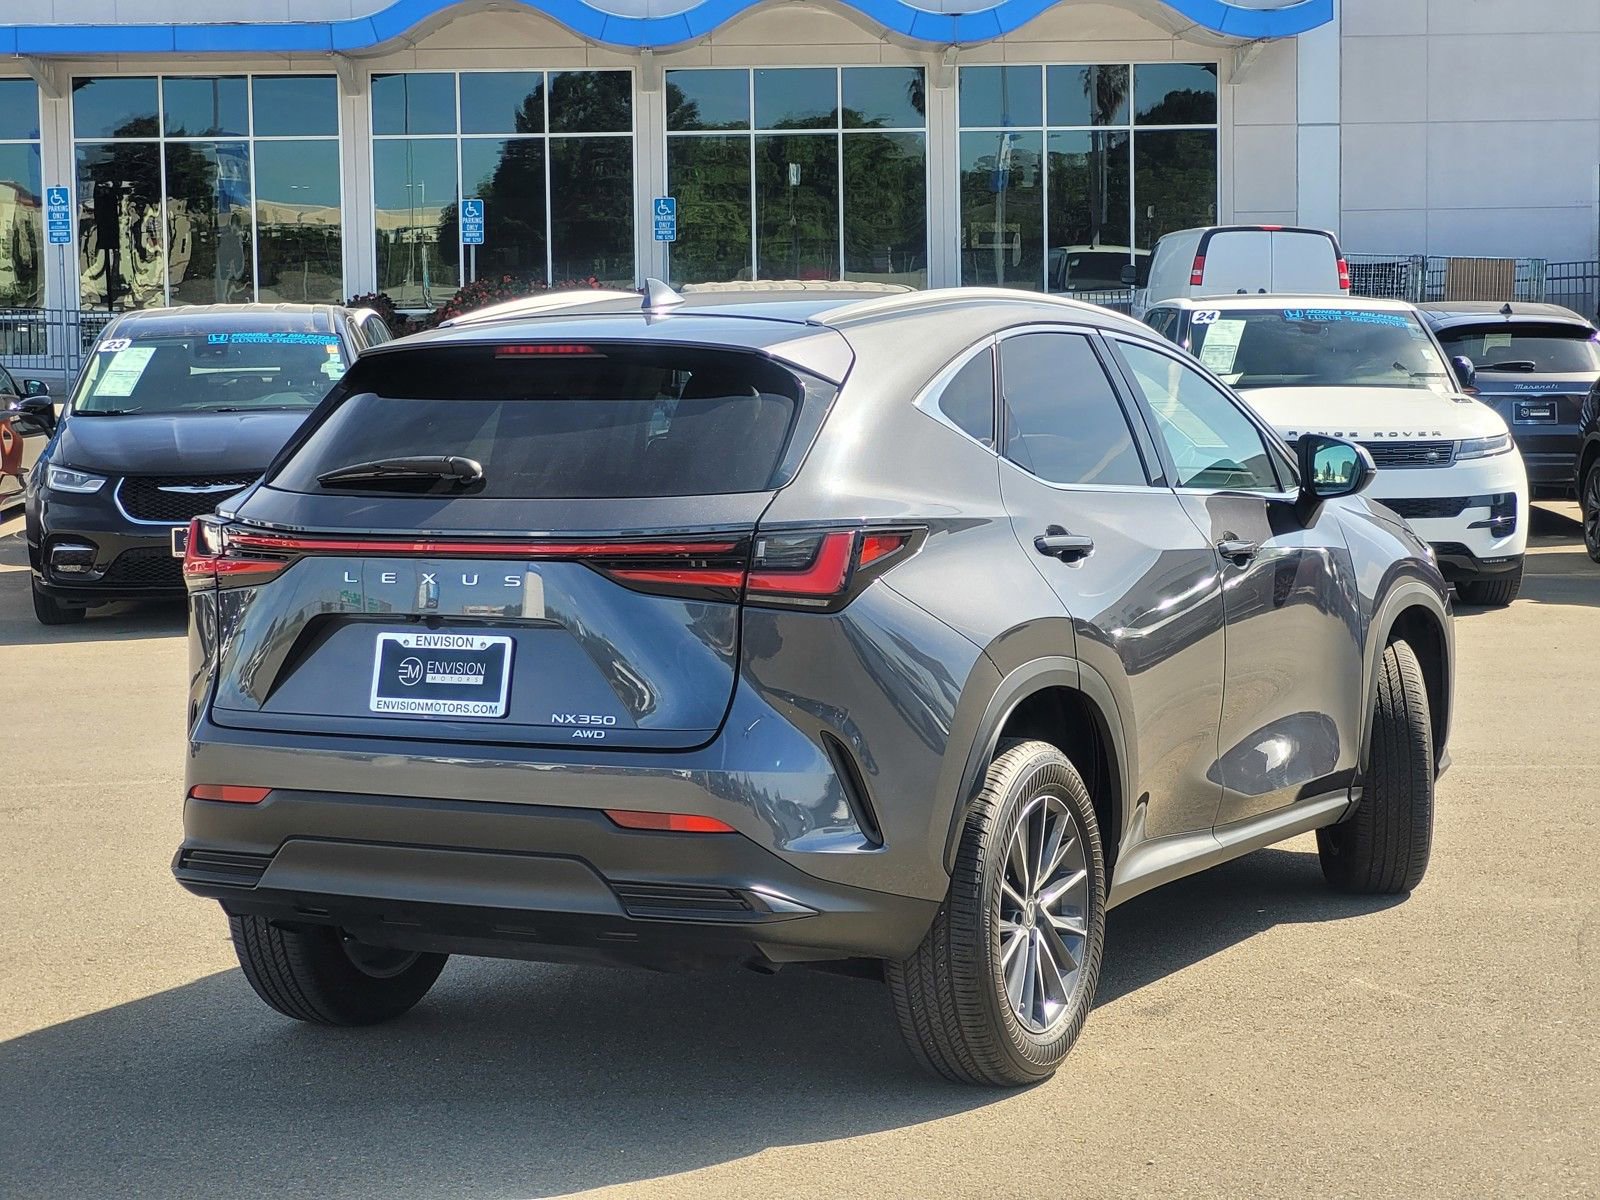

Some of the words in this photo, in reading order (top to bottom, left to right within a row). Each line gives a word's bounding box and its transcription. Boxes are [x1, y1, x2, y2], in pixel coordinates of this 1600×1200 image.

[659, 221, 671, 229] ONLY
[1195, 311, 1217, 321] 24
[230, 332, 267, 340] HONDA
[103, 340, 127, 350] 23
[1373, 430, 1442, 438] ROVER
[344, 571, 522, 587] LEXUS
[415, 635, 474, 648] ENVISION
[426, 660, 486, 675] ENVISION
[430, 675, 480, 683] MOTORS
[376, 700, 498, 715] ENVISIONMOTORS.COM
[572, 729, 605, 739] AWD
